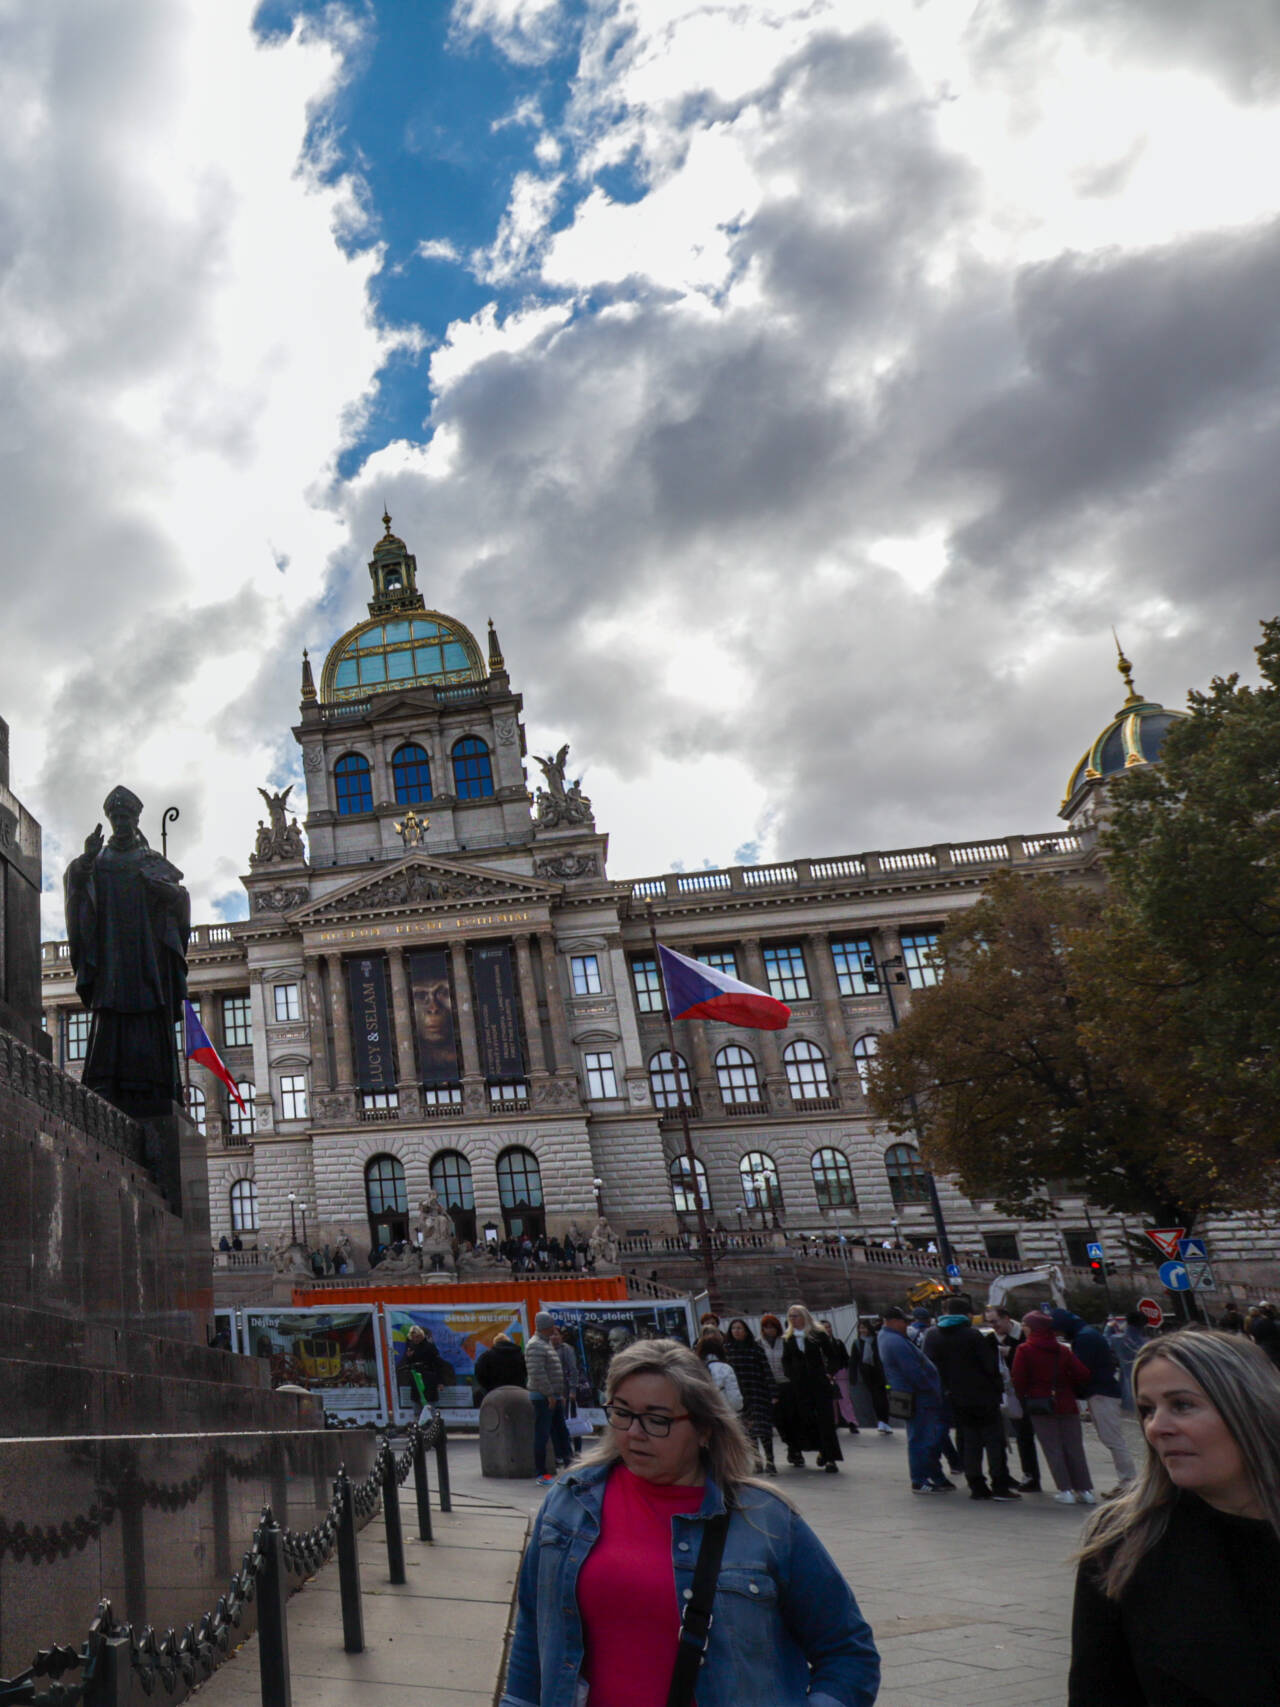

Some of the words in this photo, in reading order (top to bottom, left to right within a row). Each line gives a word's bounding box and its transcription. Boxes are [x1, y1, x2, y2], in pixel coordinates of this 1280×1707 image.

[362, 983, 378, 1030] SELAM
[368, 1032, 379, 1042] &
[368, 1047, 384, 1082] LUCY
[251, 1317, 280, 1329] Dějiny
[478, 1313, 518, 1323] muzeum
[552, 1311, 582, 1324] Dějiny
[602, 1311, 634, 1321] století
